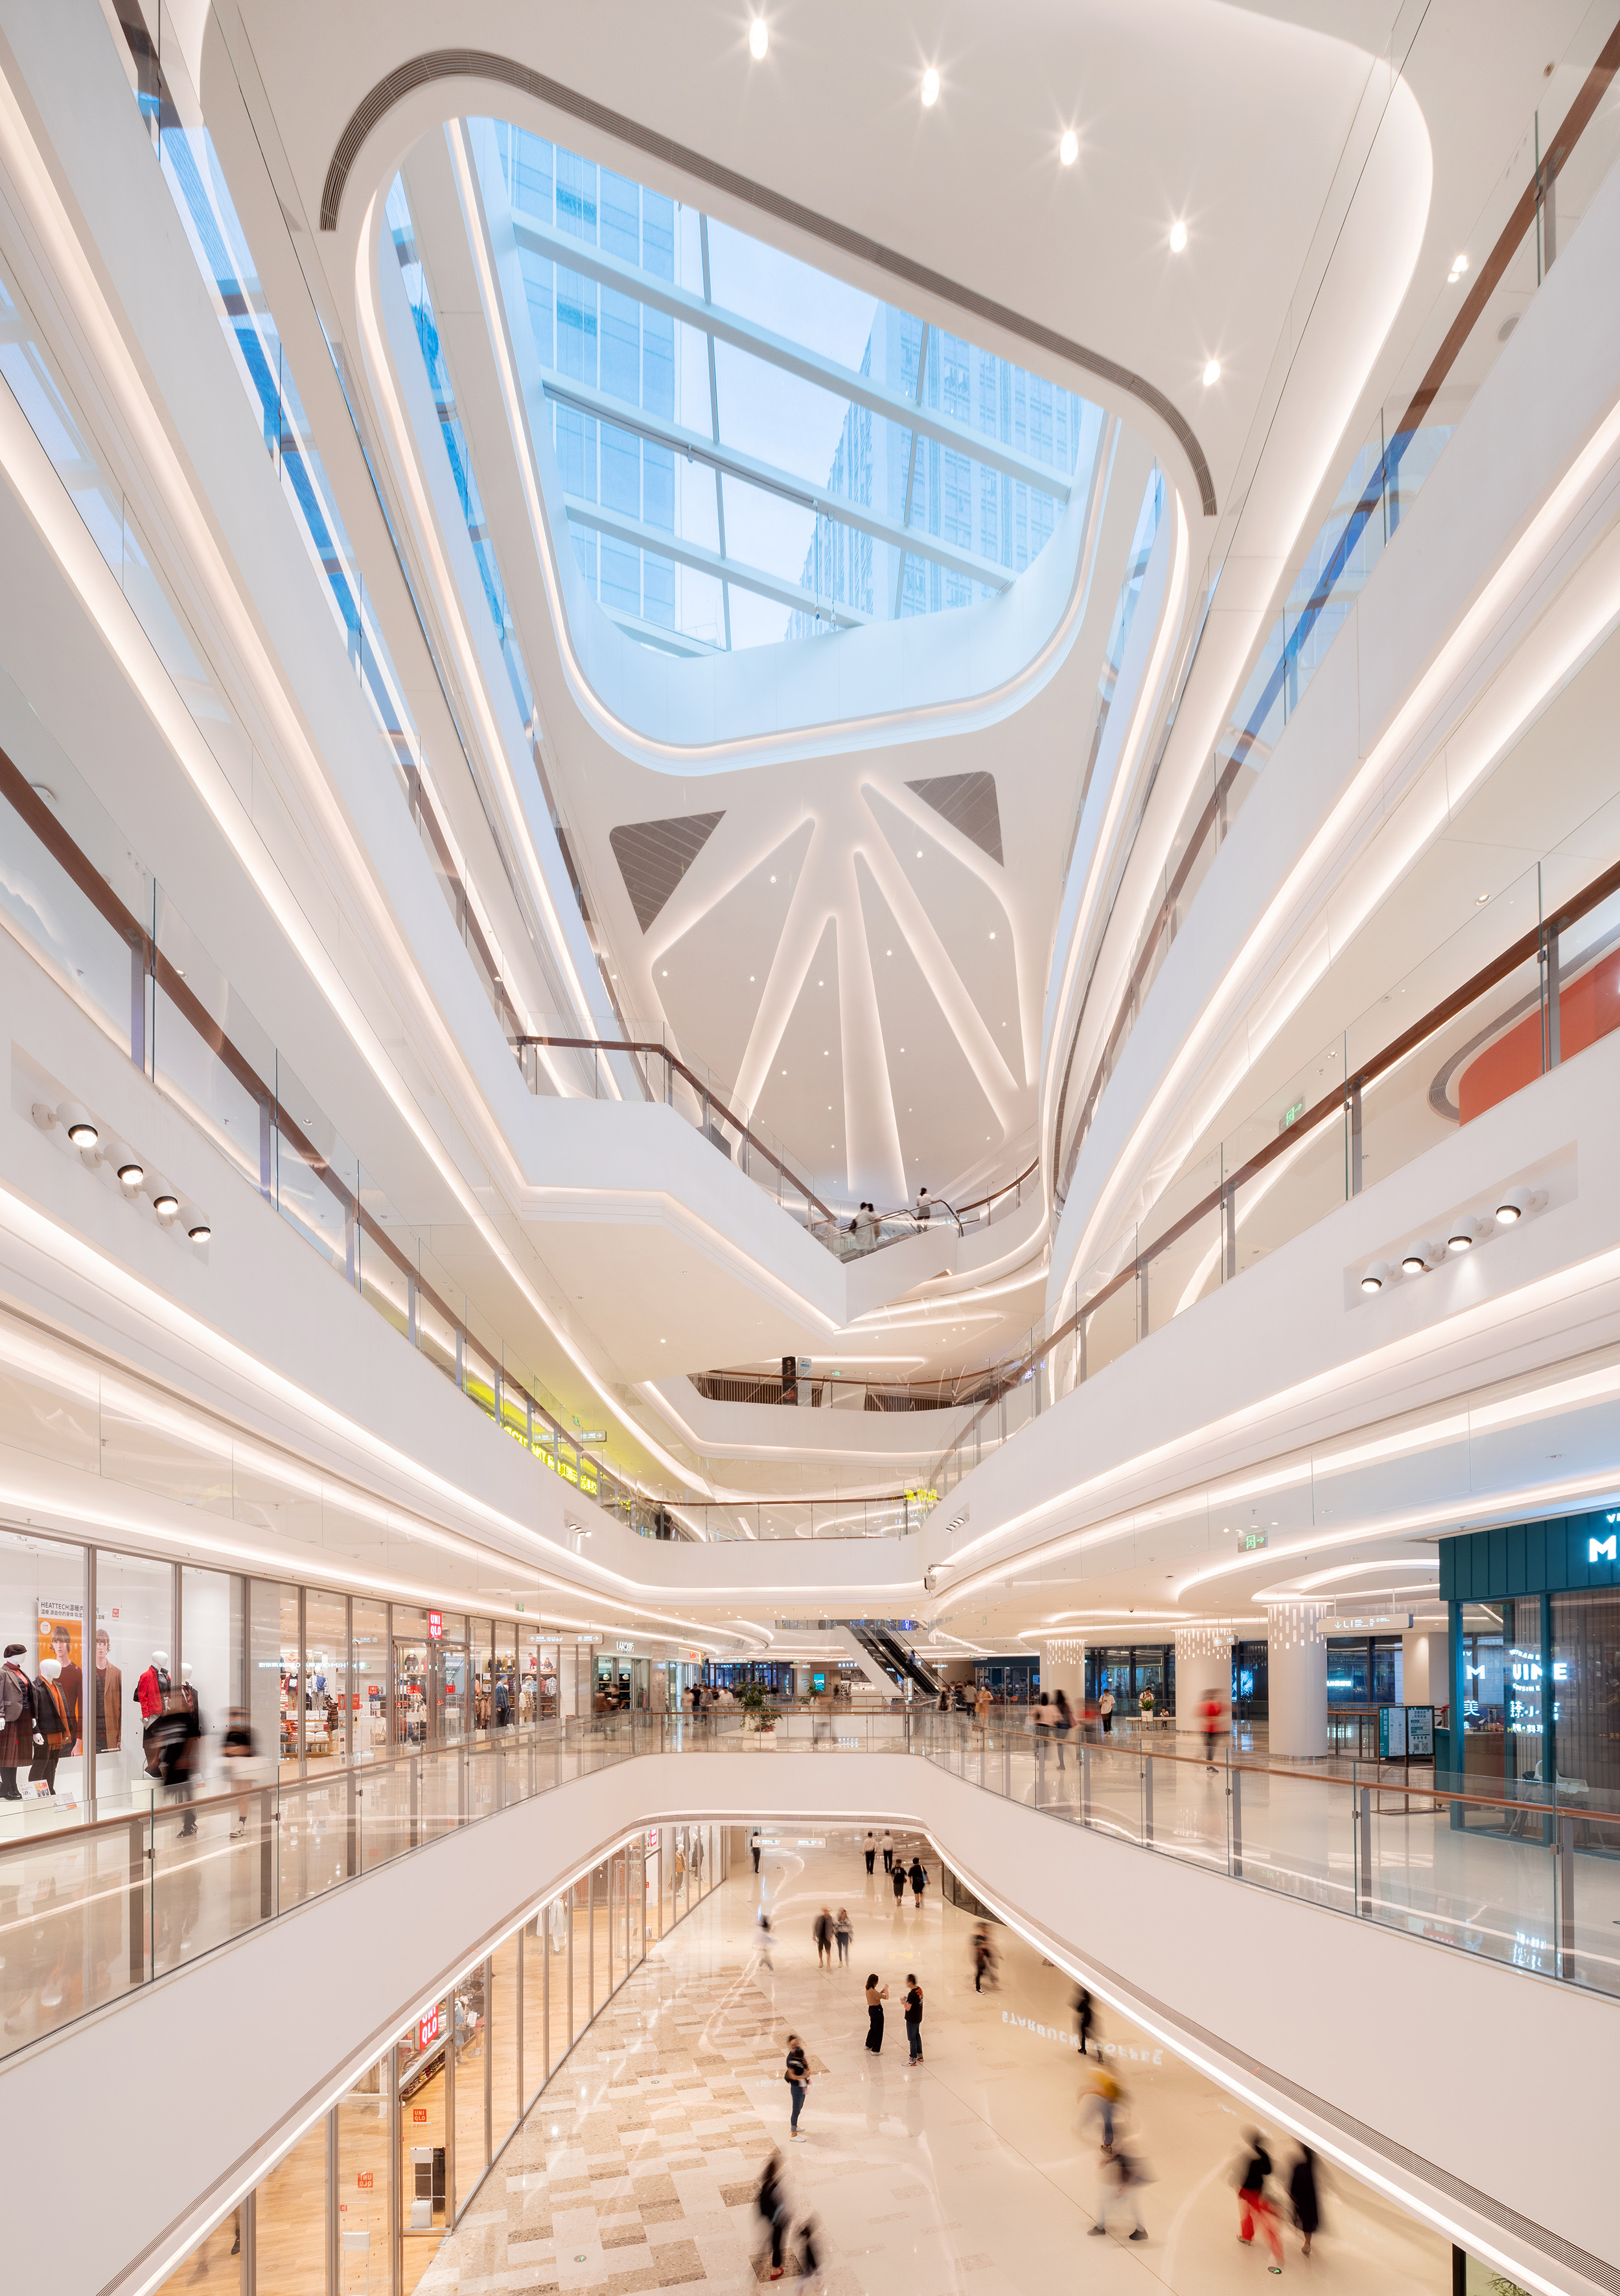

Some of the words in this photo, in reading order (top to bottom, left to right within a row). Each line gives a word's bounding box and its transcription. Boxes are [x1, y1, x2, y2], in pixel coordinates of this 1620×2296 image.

[430, 1614, 441, 1624] UNI
[430, 1625, 441, 1636] QLO
[422, 2017, 437, 2045] QLO
